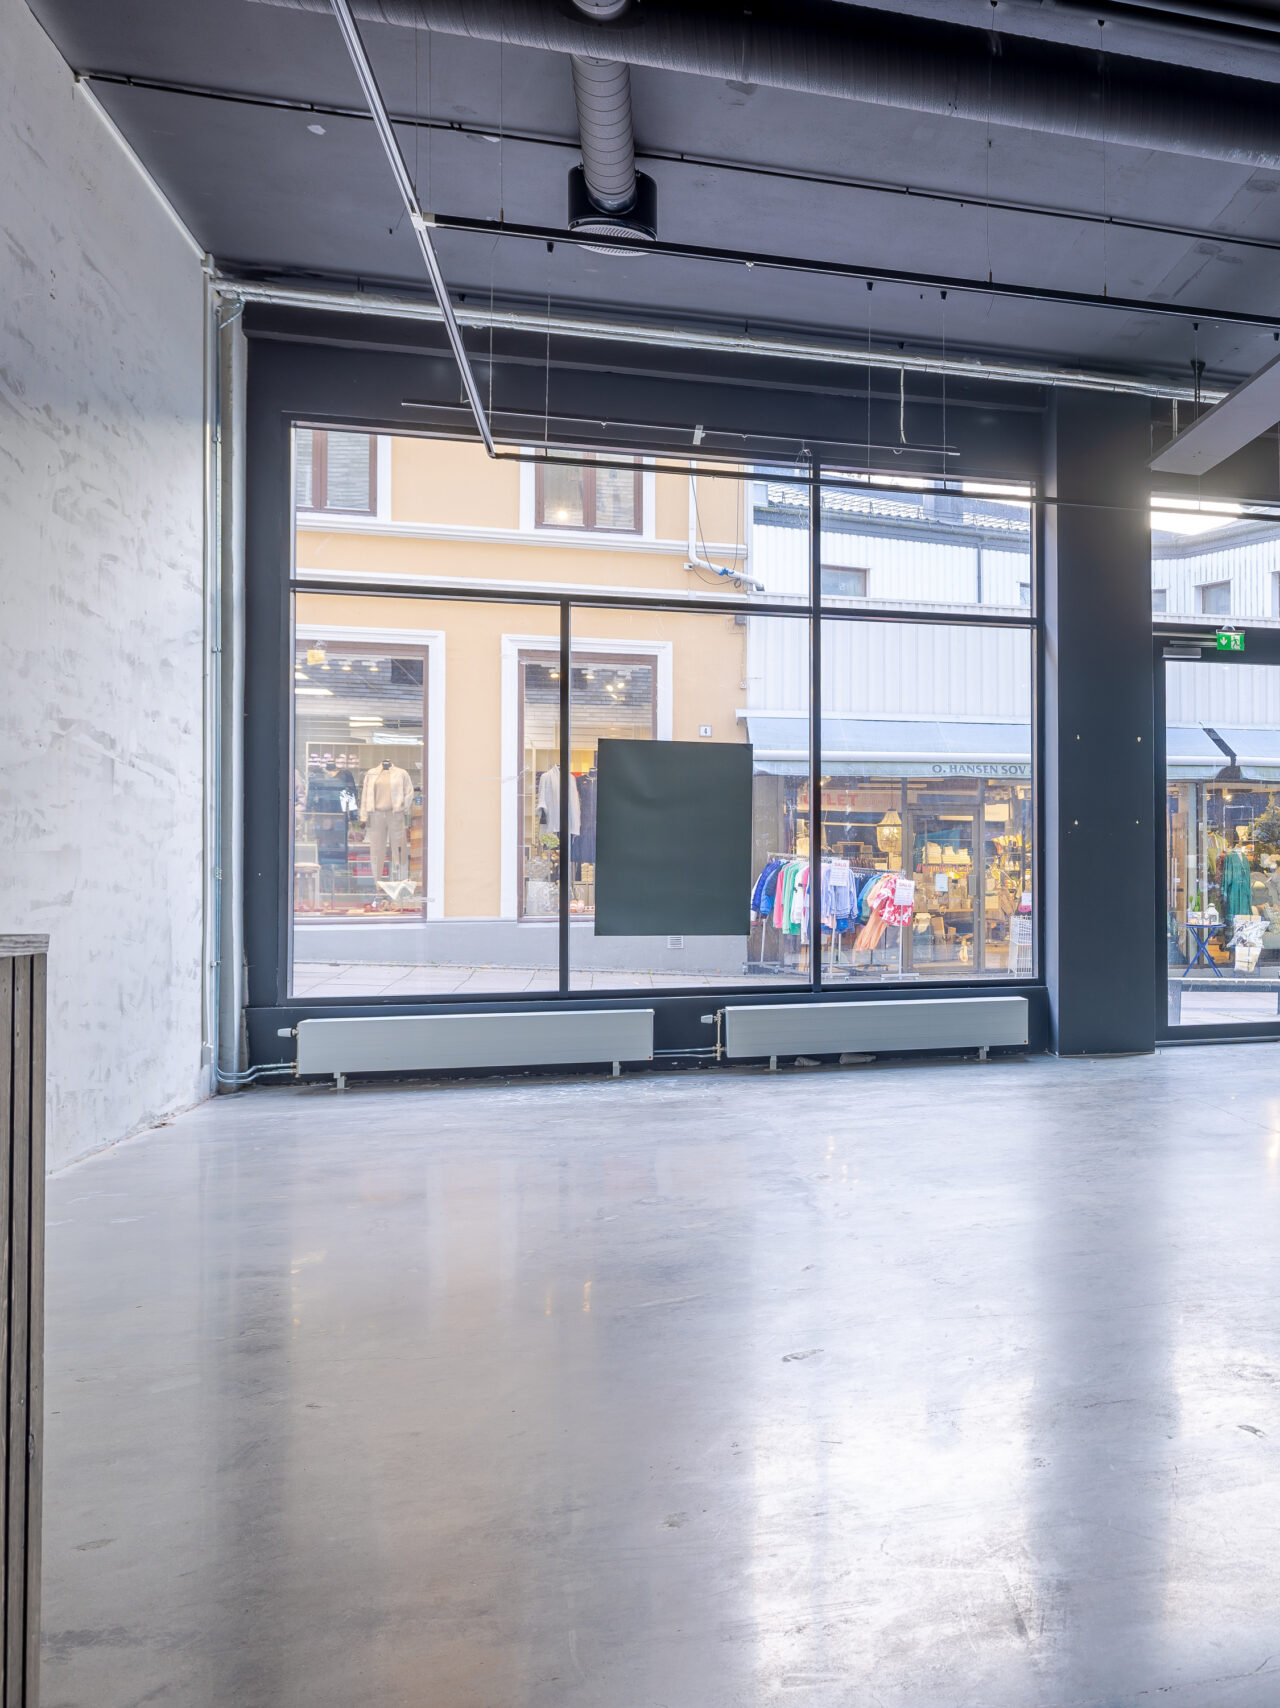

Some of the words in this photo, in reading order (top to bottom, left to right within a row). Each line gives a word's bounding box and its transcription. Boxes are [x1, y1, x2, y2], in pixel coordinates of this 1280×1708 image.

[932, 764, 946, 774] O.
[949, 764, 998, 774] HANSEN
[1001, 765, 1026, 775] SOV
